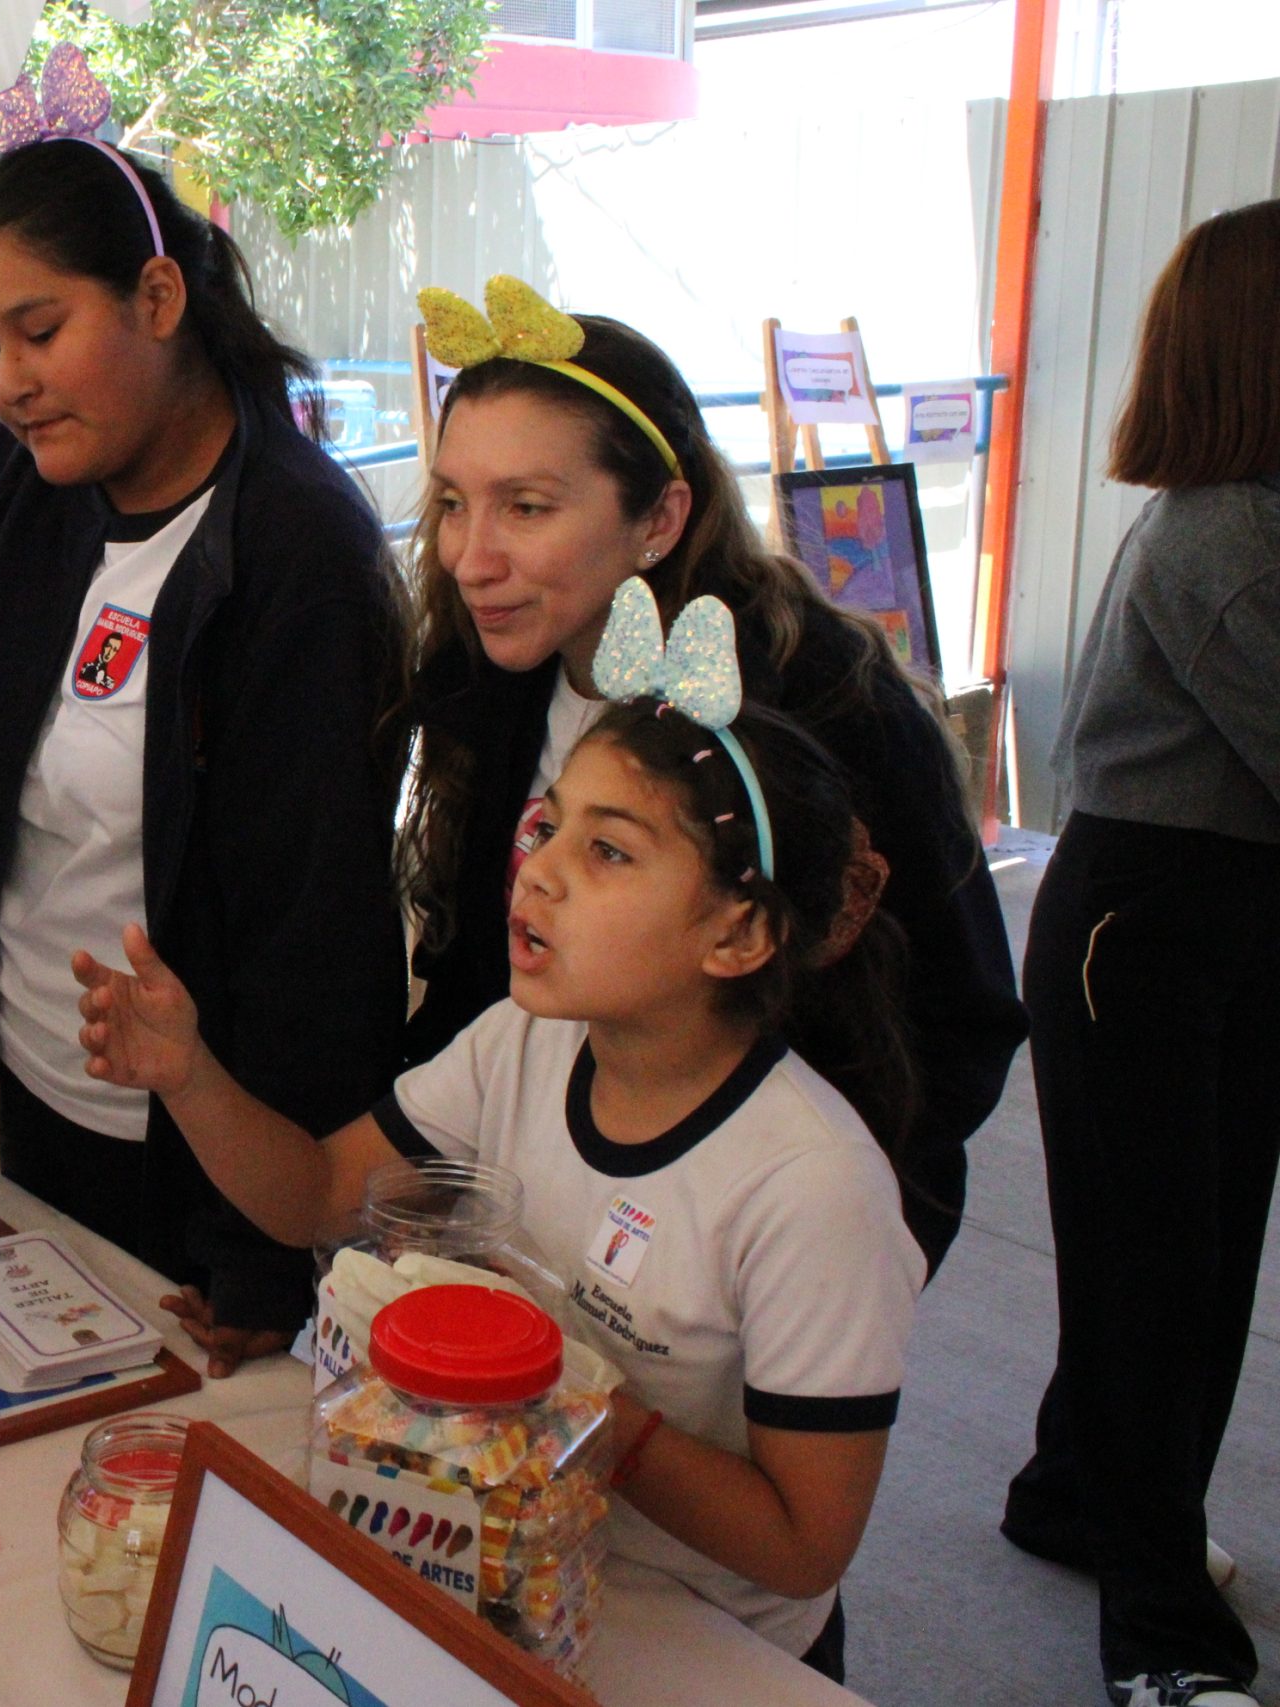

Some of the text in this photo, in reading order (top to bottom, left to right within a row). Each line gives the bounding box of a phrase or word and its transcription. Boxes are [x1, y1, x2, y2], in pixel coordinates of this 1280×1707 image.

[108, 611, 141, 630] ESCUELA
[9, 1279, 50, 1293] ARTE
[28, 1289, 49, 1298] DE
[15, 1292, 74, 1309] TALLER
[591, 1283, 632, 1323] Escuela
[570, 1279, 671, 1356] Manuel Rodriguez
[419, 1559, 476, 1594] ARTES
